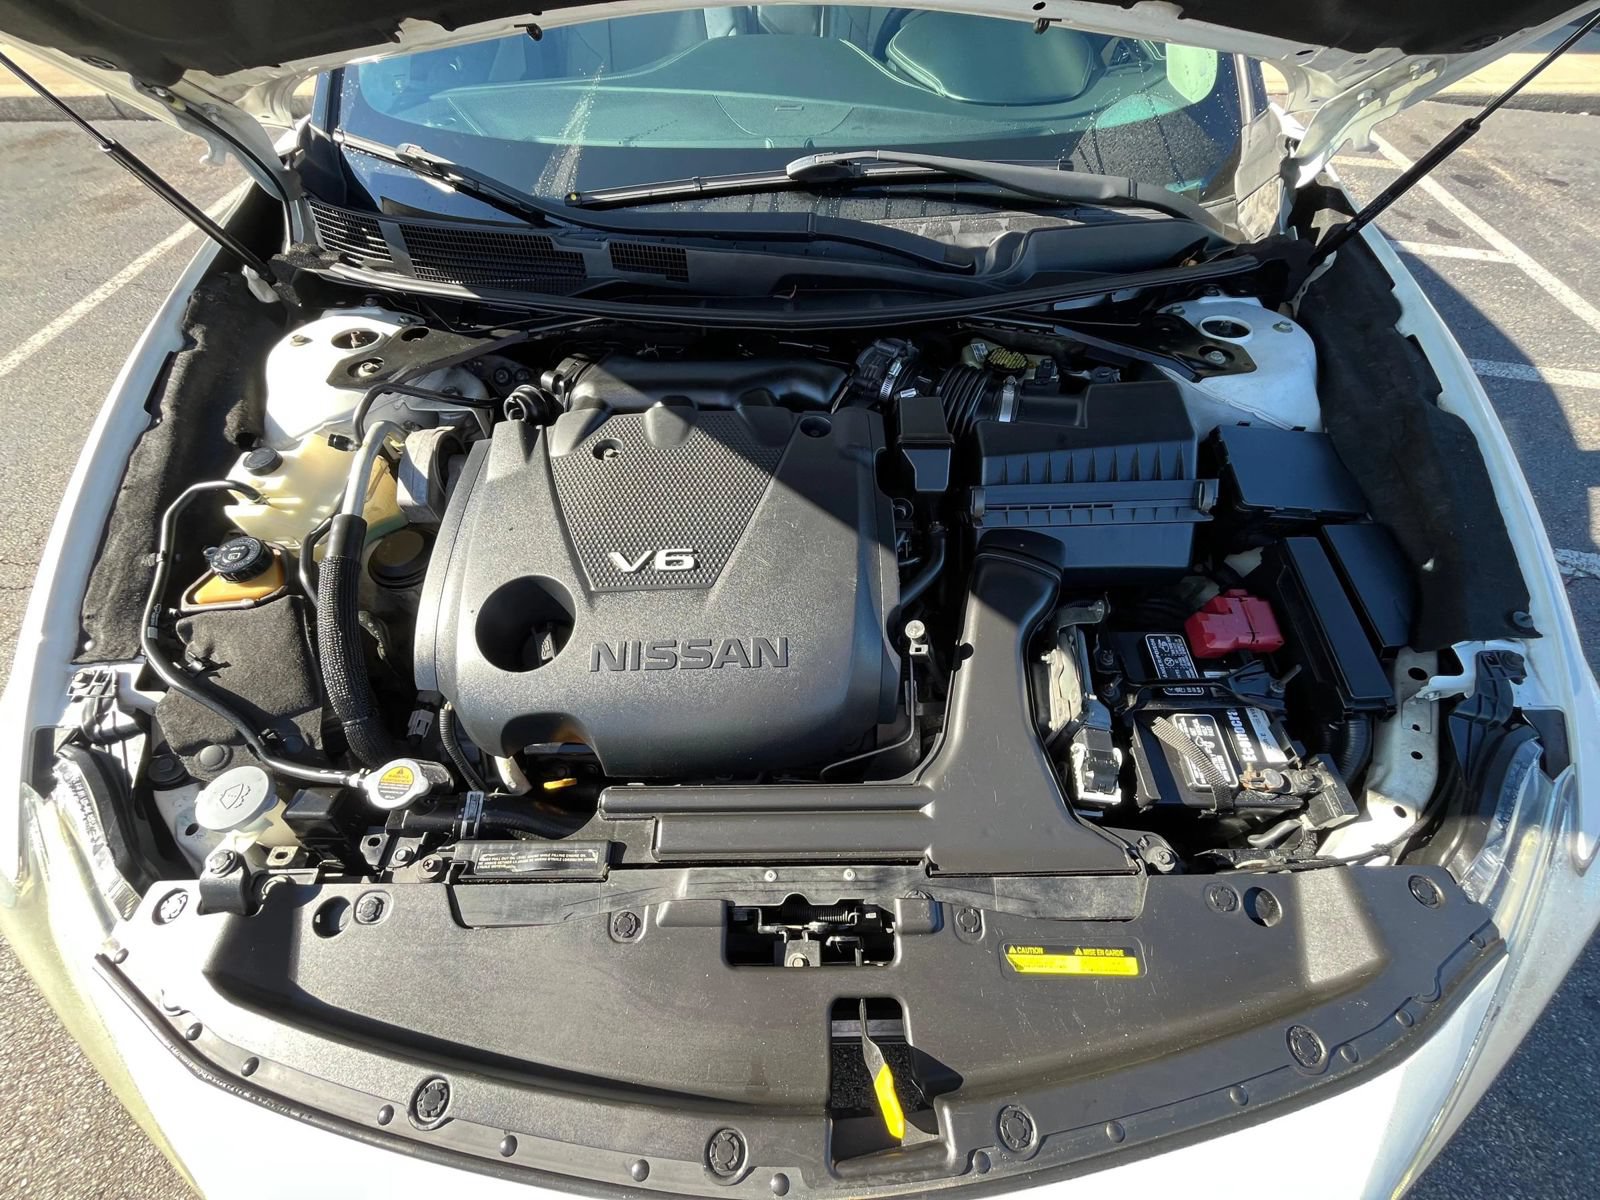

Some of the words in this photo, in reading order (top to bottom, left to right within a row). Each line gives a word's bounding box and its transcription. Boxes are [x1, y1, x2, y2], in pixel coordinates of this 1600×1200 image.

[608, 548, 698, 572] V6
[589, 637, 789, 672] NISSAN
[1017, 947, 1044, 955] CAUTION
